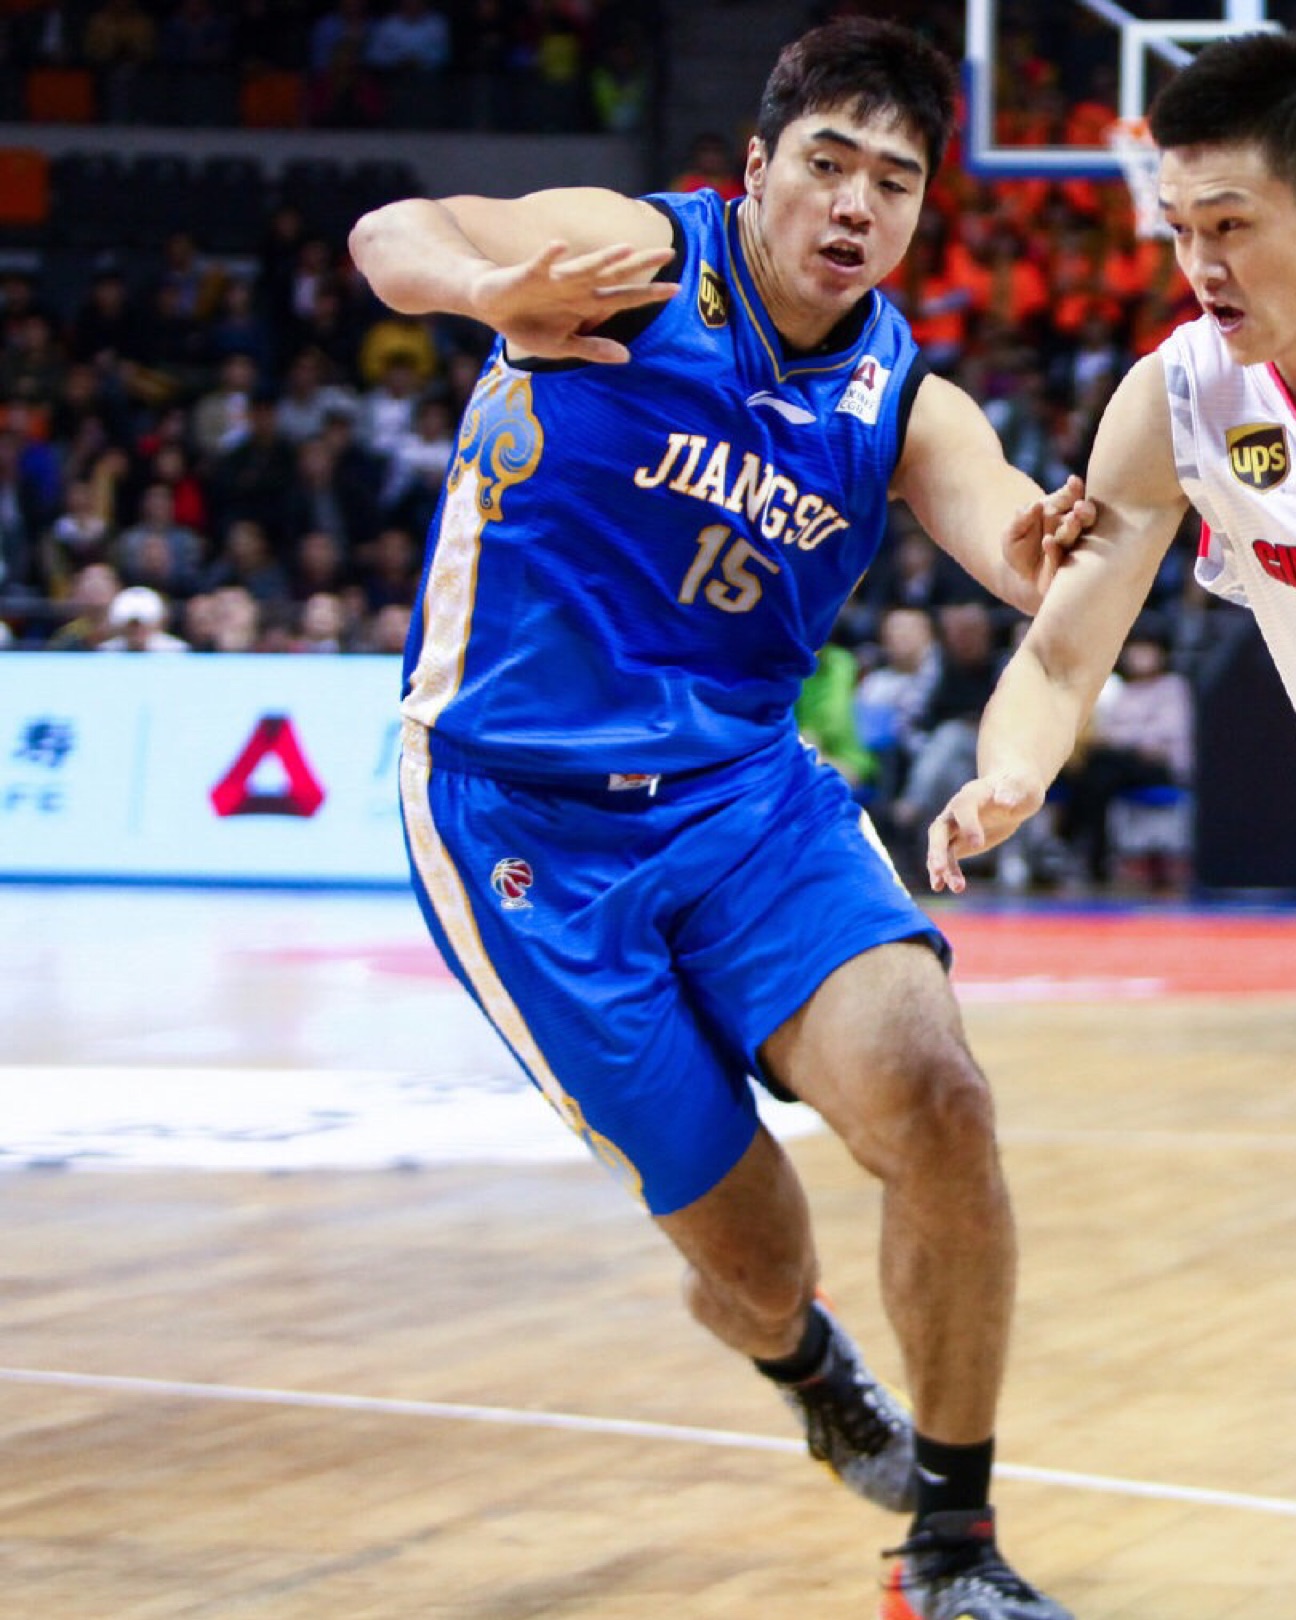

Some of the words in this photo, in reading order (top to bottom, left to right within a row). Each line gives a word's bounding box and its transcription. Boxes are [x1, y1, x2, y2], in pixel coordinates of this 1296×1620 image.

[634, 433, 850, 551] JIANGSU
[1231, 442, 1286, 484] ups
[677, 524, 781, 614] 15
